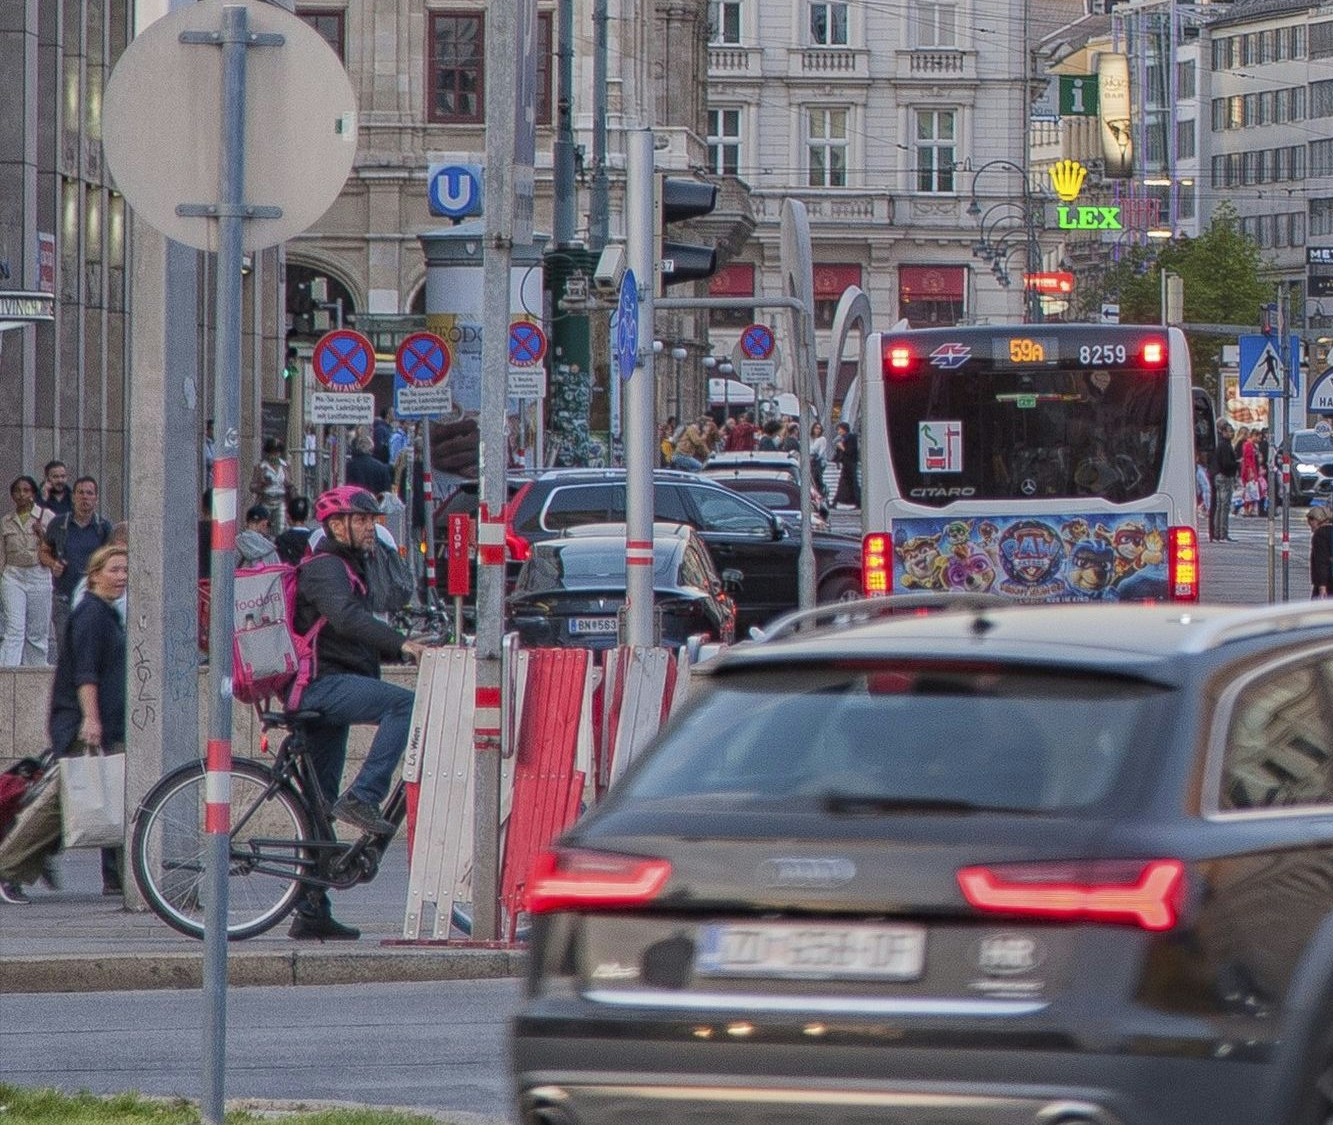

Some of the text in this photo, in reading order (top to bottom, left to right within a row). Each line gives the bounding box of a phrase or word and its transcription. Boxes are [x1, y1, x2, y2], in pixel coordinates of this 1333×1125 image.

[437, 175, 471, 211] U
[1056, 206, 1123, 230] LEX
[1009, 338, 1044, 363] 59A
[1079, 344, 1127, 365] 8259
[327, 381, 362, 393] ANFANG
[909, 486, 976, 498] CITARO
[453, 517, 462, 549] STOP
[1001, 535, 1063, 561] PAW
[235, 592, 281, 612] foodora
